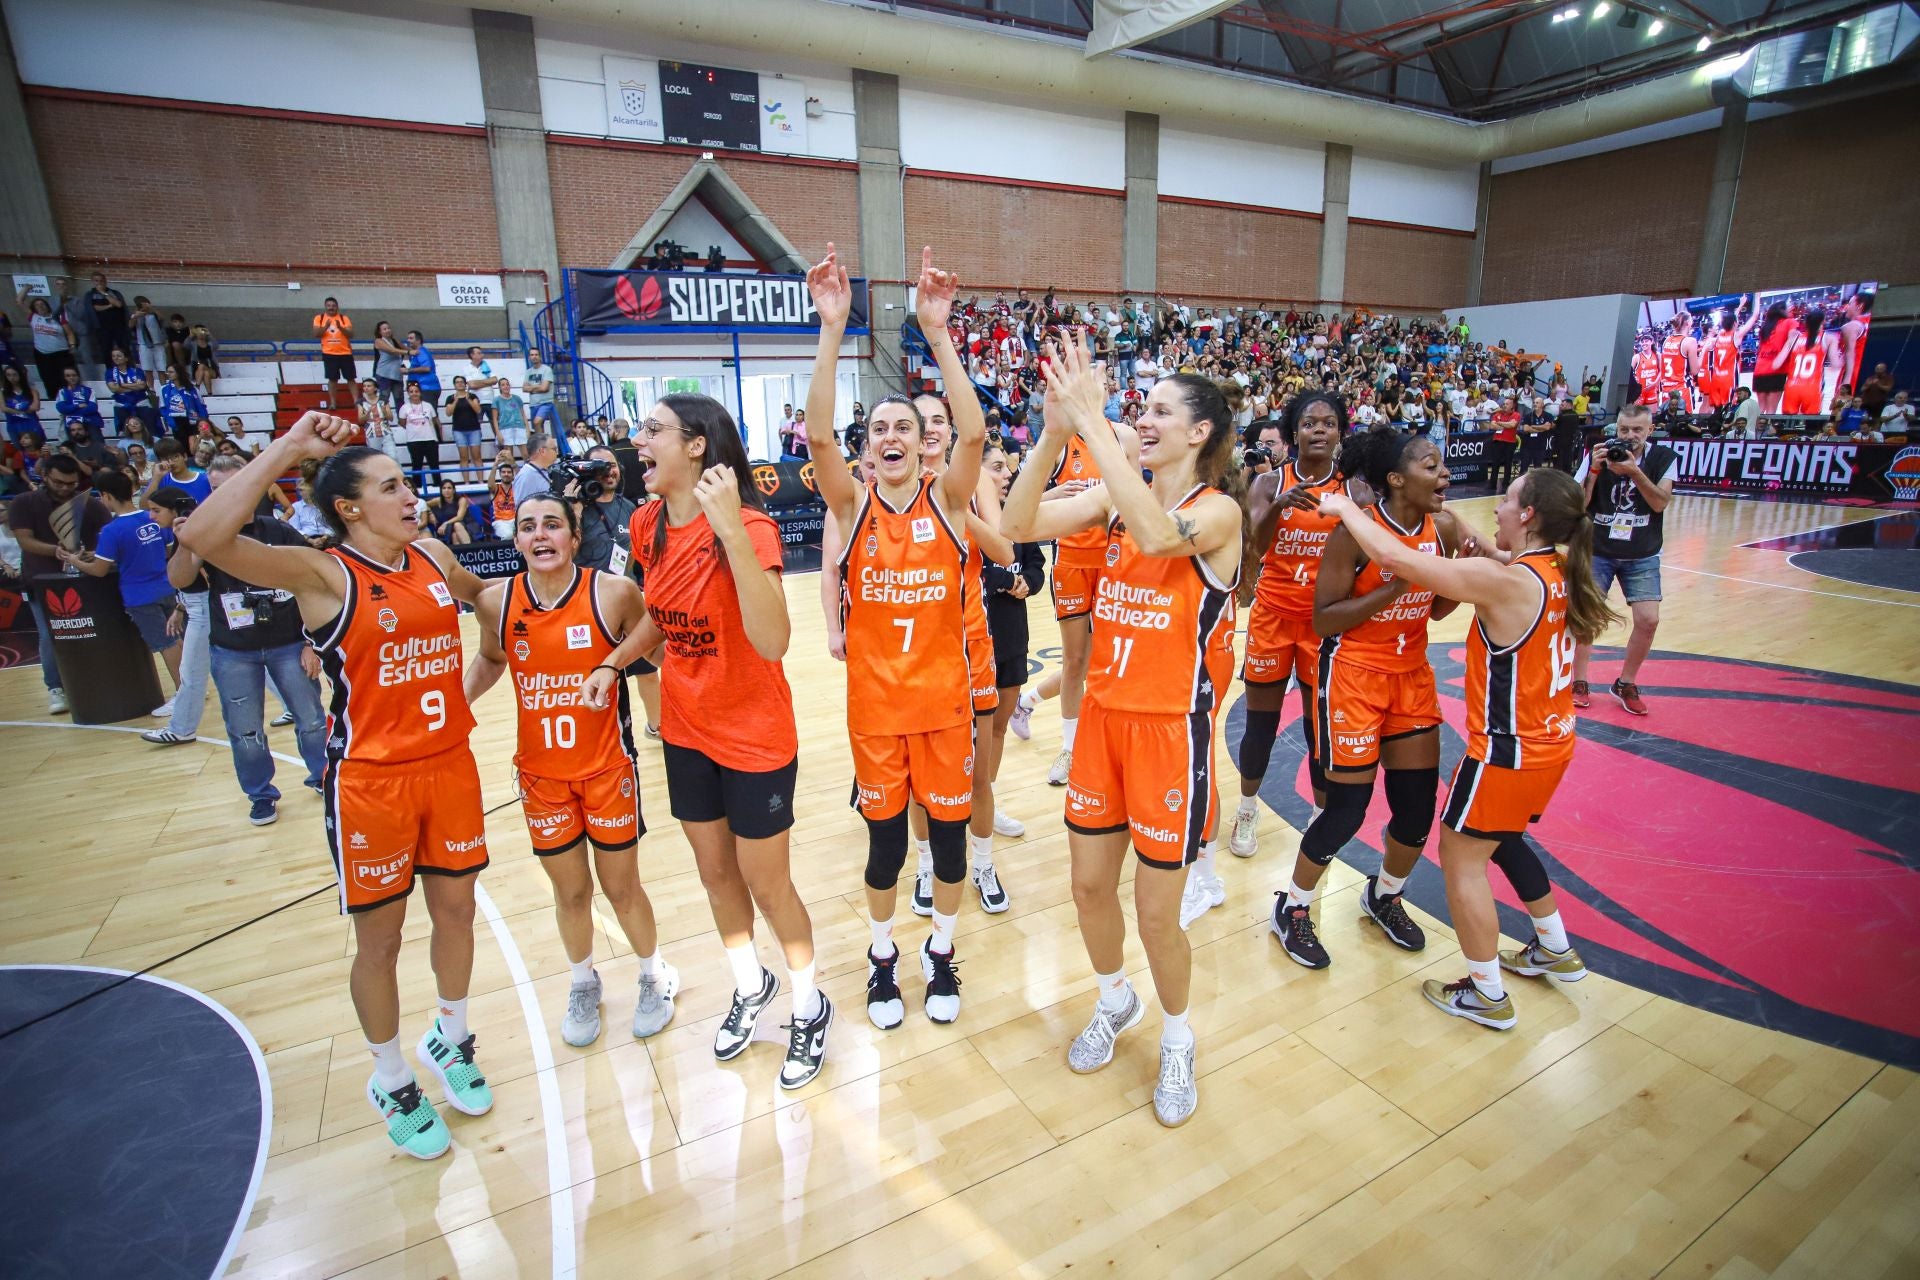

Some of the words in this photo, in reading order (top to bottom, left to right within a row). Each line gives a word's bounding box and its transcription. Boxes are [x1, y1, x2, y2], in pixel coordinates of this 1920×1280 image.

[664, 84, 692, 95] LOCAL
[729, 92, 756, 103] VISITANTE
[612, 115, 658, 127] Alcantarilla
[668, 136, 688, 144] FALTAS
[450, 286, 490, 294] GRADA
[455, 295, 489, 304] OESTE
[1794, 354, 1817, 377] 10
[1278, 527, 1329, 544] Cultura
[861, 566, 928, 586] Cultura
[929, 569, 944, 582] del
[1293, 563, 1310, 587] 4
[861, 584, 947, 605] Esfuerzo
[1098, 576, 1156, 605] Cultura
[1153, 593, 1173, 606] del
[1058, 596, 1084, 606] PULEVA
[690, 615, 709, 628] del
[893, 618, 915, 653] 7
[1396, 633, 1407, 655] 1
[378, 634, 452, 663] Cultura
[1105, 636, 1134, 678] 11
[1247, 655, 1277, 667] PULEVA
[420, 689, 446, 732] 9
[540, 714, 577, 749] 10
[528, 813, 570, 829] PULEVA
[587, 813, 634, 828] Vitaldin
[358, 853, 410, 878] PULEVA
